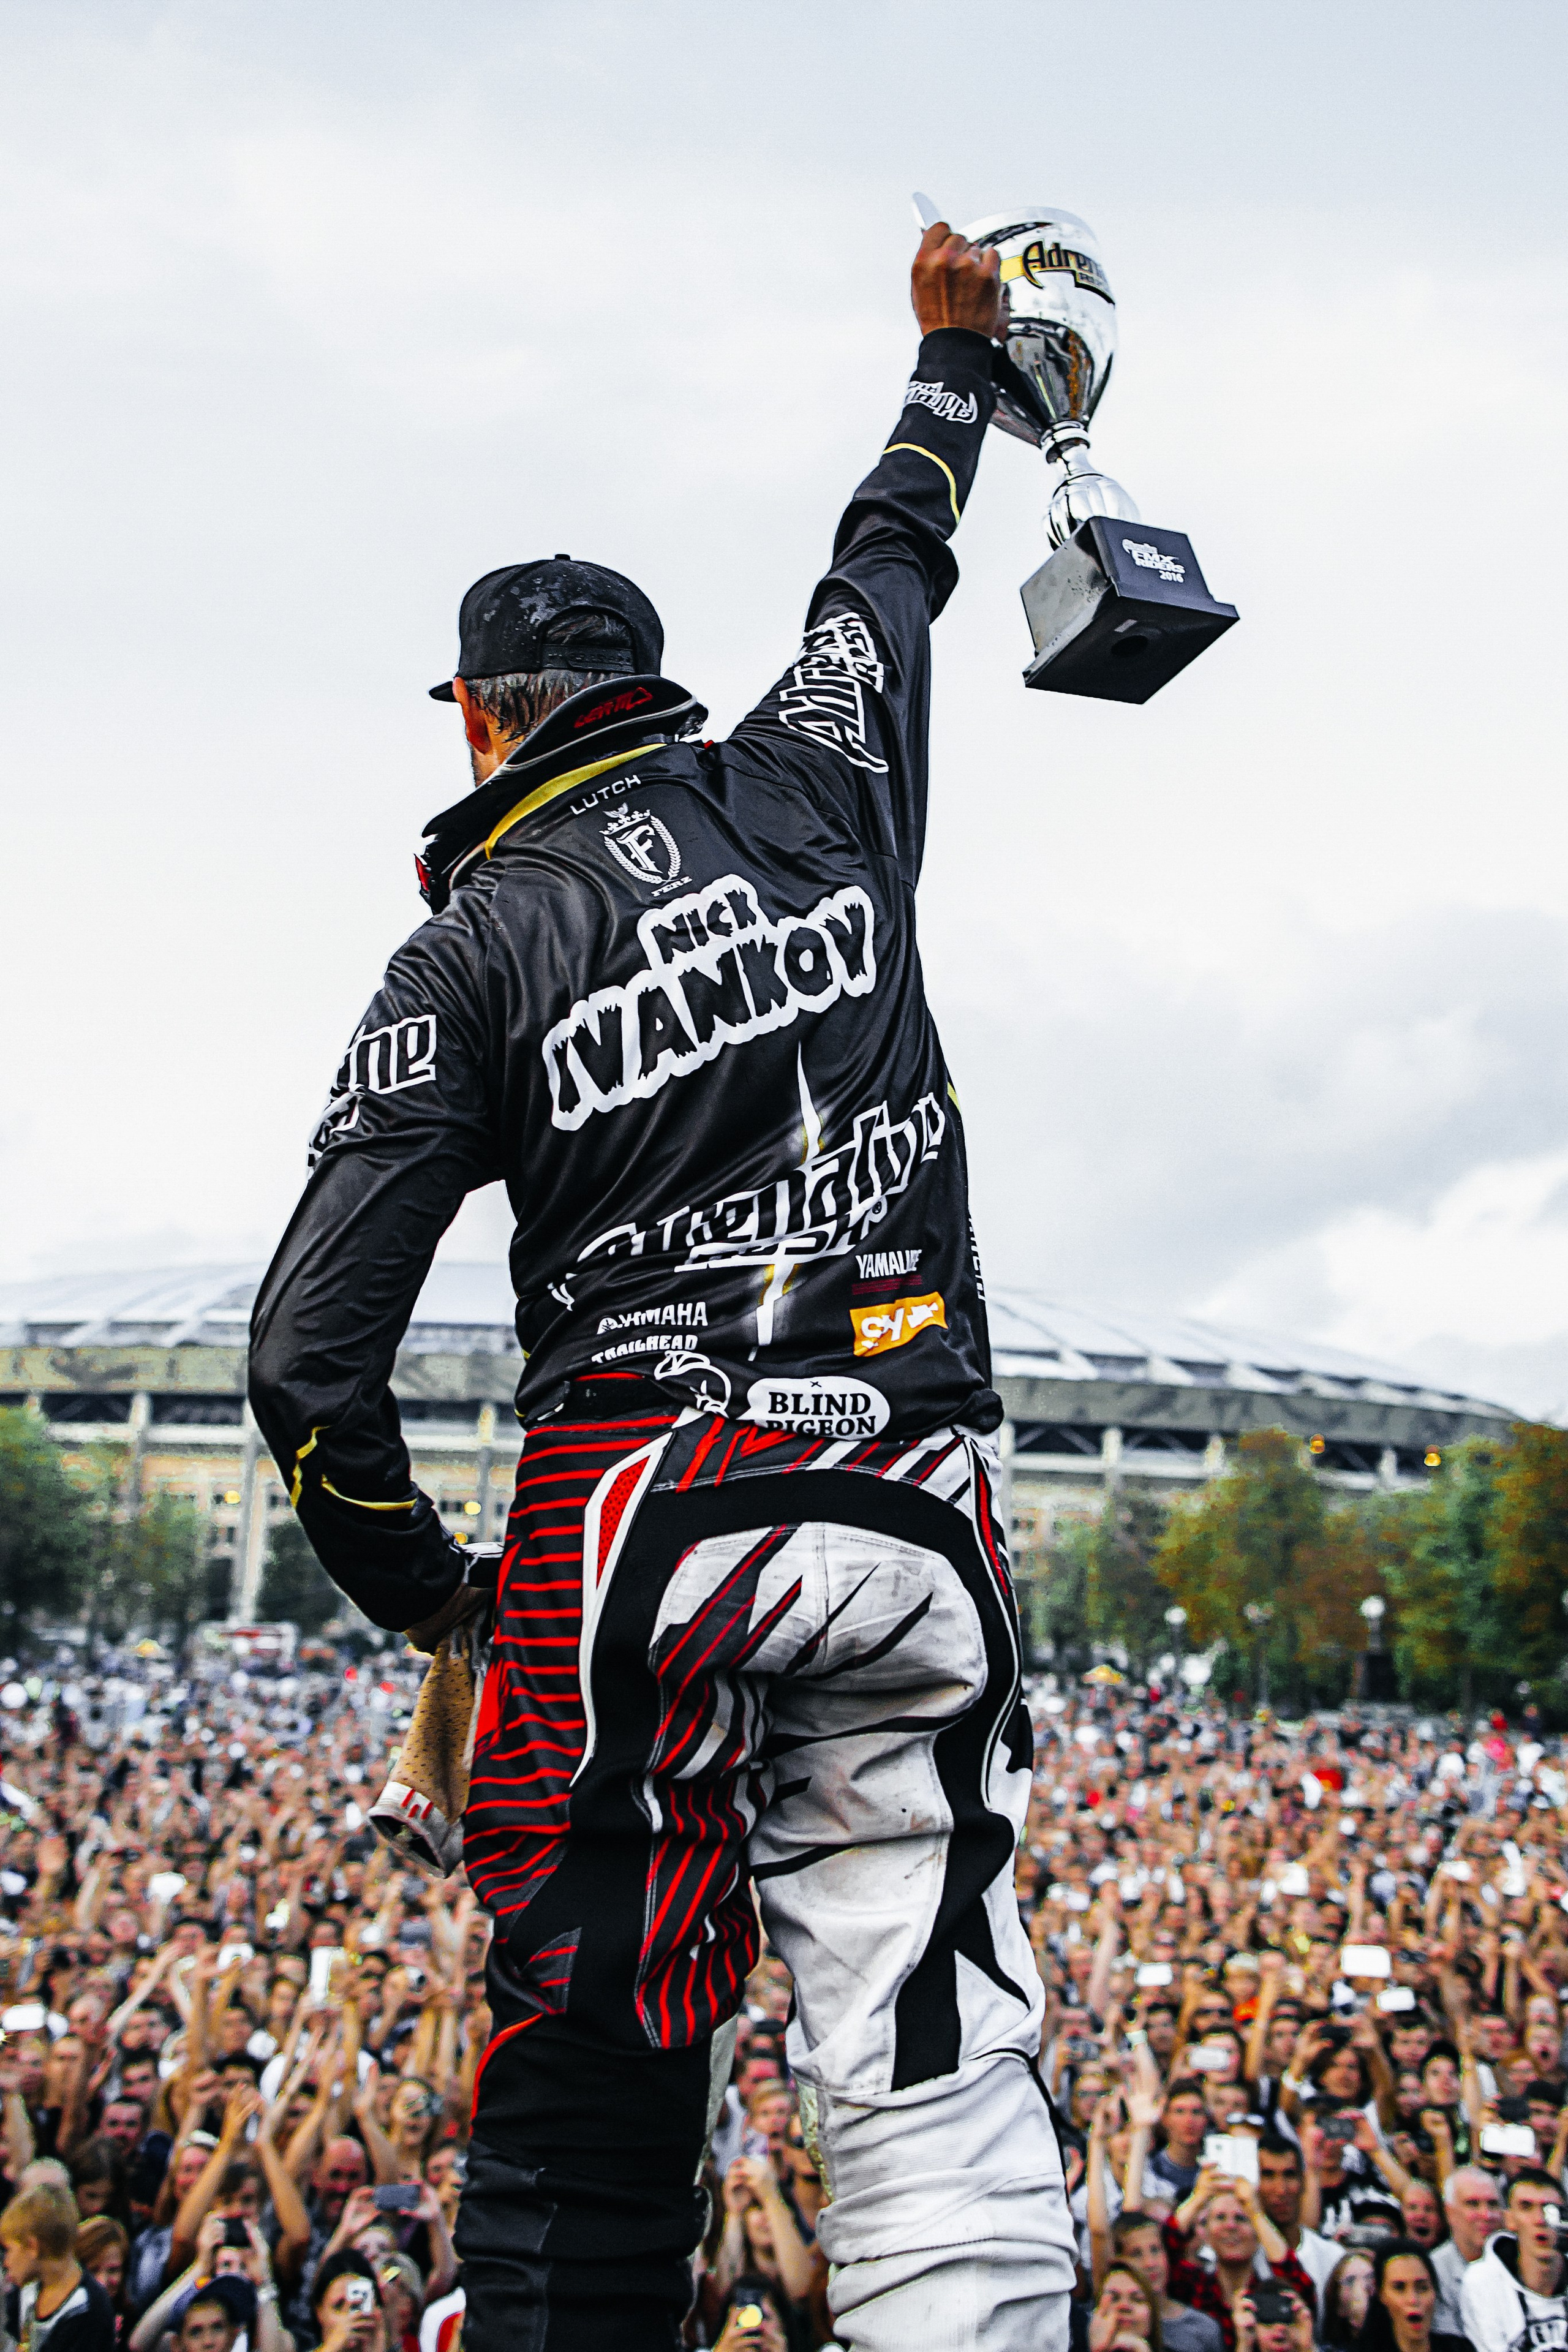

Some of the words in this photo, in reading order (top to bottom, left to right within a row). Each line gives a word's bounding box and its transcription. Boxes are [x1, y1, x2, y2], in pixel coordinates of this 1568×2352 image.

[1132, 551, 1179, 565] FMX
[1135, 557, 1186, 574] RIDERS
[1159, 570, 1184, 583] 2016
[570, 774, 641, 815] LUTCH
[651, 876, 693, 897] FERZ
[649, 886, 760, 965] NICK
[550, 900, 869, 1117] IVANKOV
[591, 1335, 698, 1364] TRAILHEAD
[768, 1391, 871, 1416] BLIND
[766, 1415, 876, 1436] PIGEON
